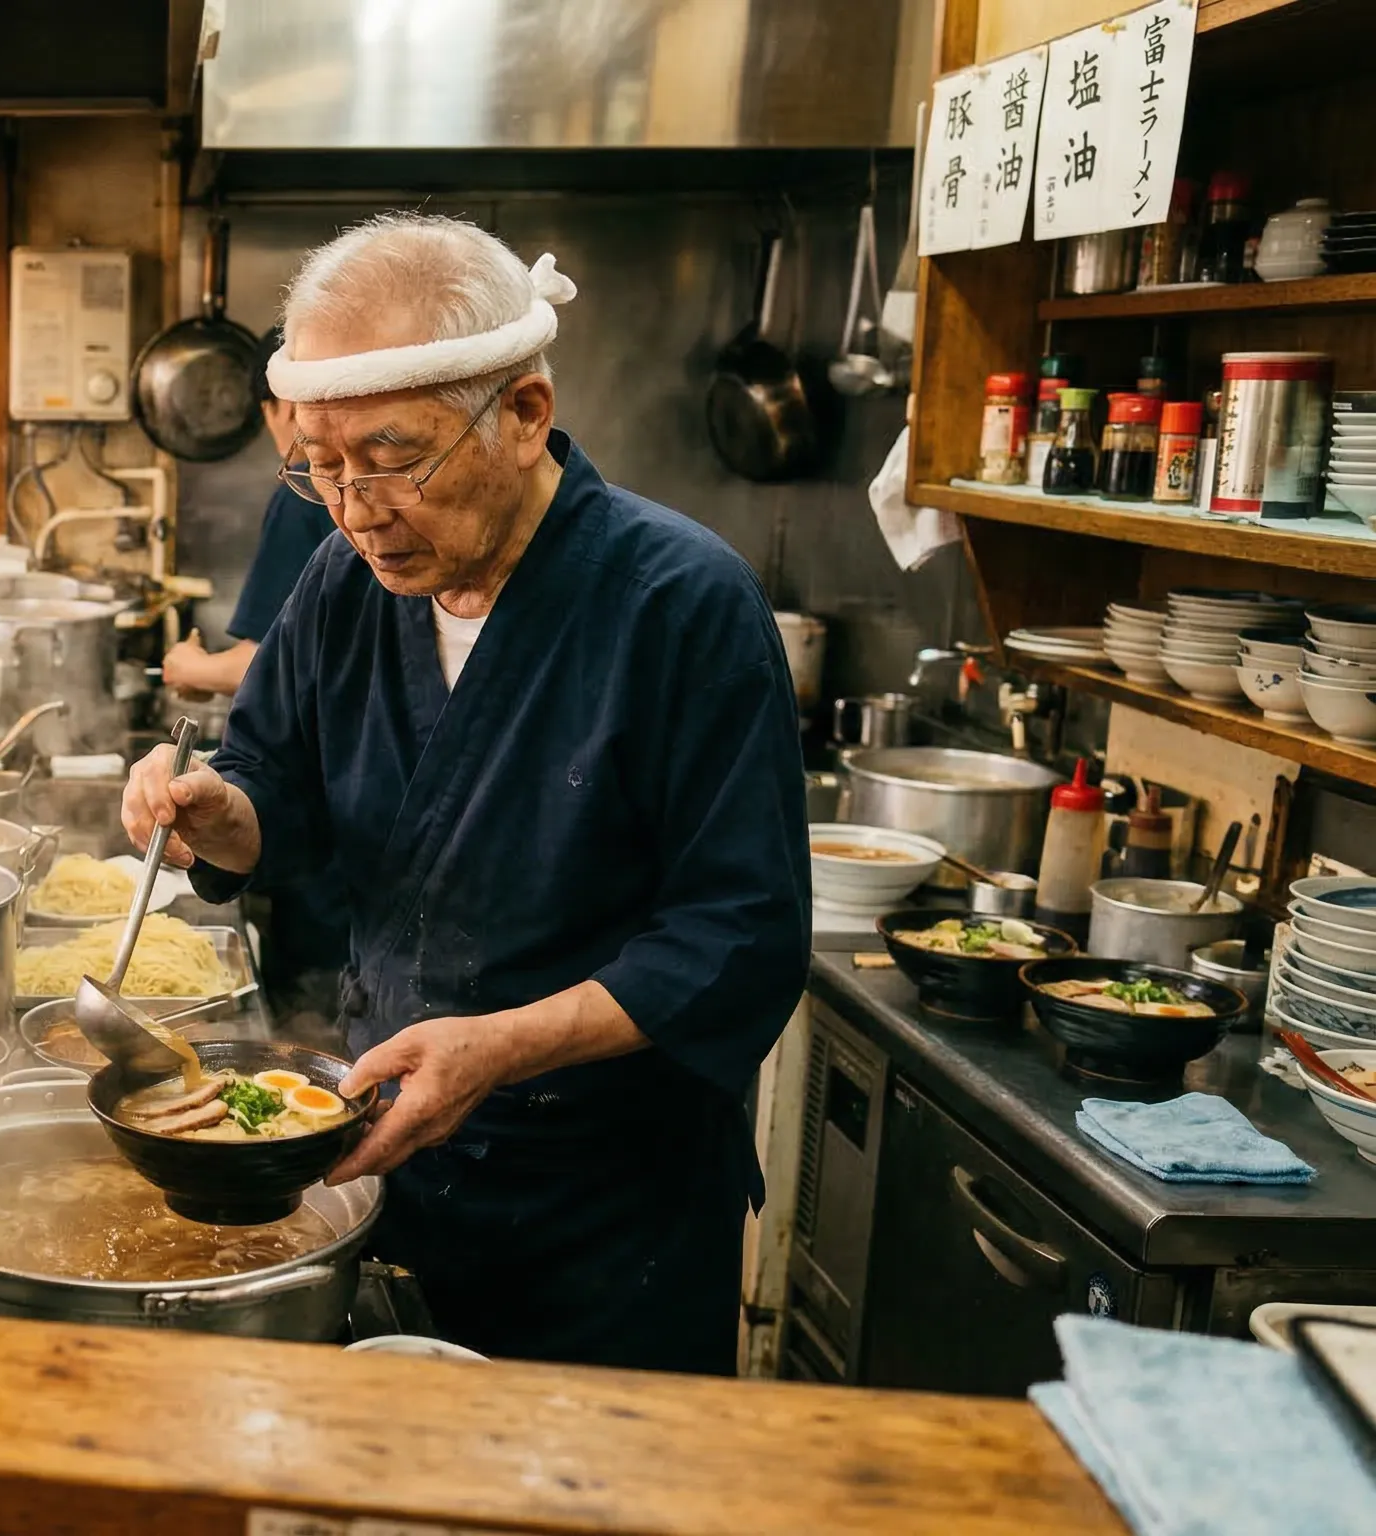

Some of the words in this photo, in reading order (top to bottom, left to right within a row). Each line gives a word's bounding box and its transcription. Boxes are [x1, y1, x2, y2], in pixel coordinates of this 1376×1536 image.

[941, 90, 974, 208] 豚骨
[995, 67, 1031, 193] 醤油
[1063, 50, 1101, 188] 塩油
[1132, 15, 1171, 218] 富士ラーメン
